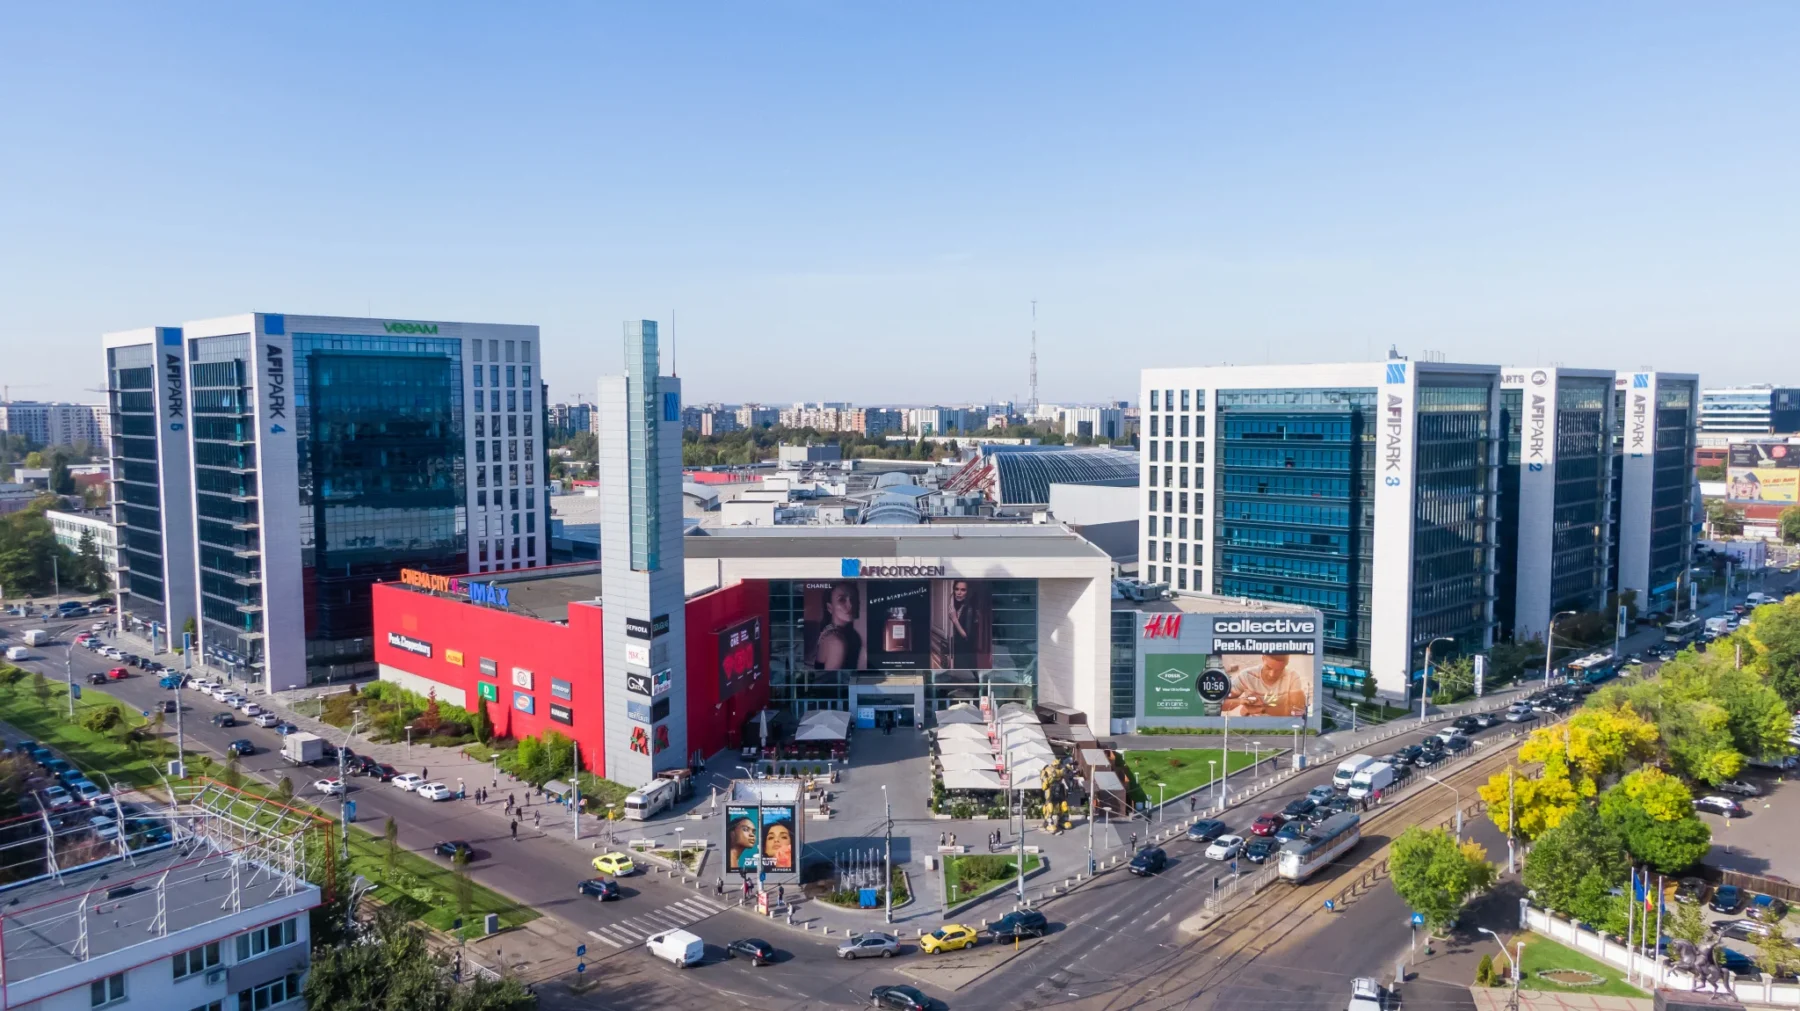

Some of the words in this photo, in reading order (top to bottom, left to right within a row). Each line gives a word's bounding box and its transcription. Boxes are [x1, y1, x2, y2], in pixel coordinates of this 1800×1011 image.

[270, 424, 286, 434] 4
[1529, 462, 1543, 472] 2
[1385, 476, 1400, 487] 3
[469, 582, 509, 607] IMAX
[1143, 613, 1183, 639] H&M
[1214, 619, 1315, 633] collective
[1203, 681, 1225, 691] 10:56
